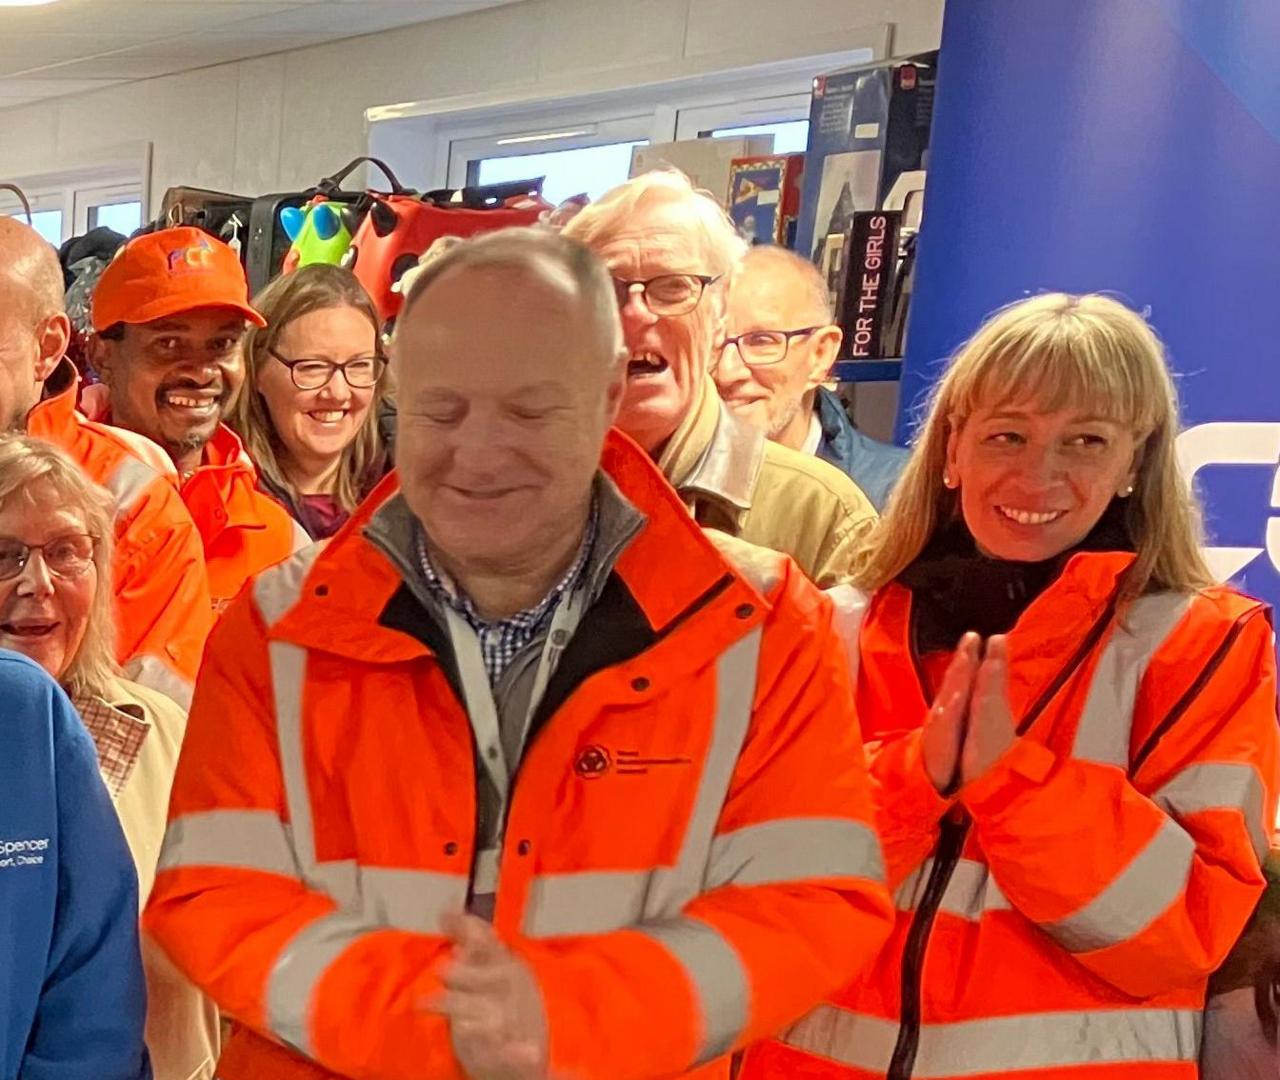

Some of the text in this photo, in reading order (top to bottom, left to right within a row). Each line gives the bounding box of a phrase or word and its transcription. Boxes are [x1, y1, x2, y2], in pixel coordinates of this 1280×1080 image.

[853, 216, 887, 357] FOR THE GIRLS
